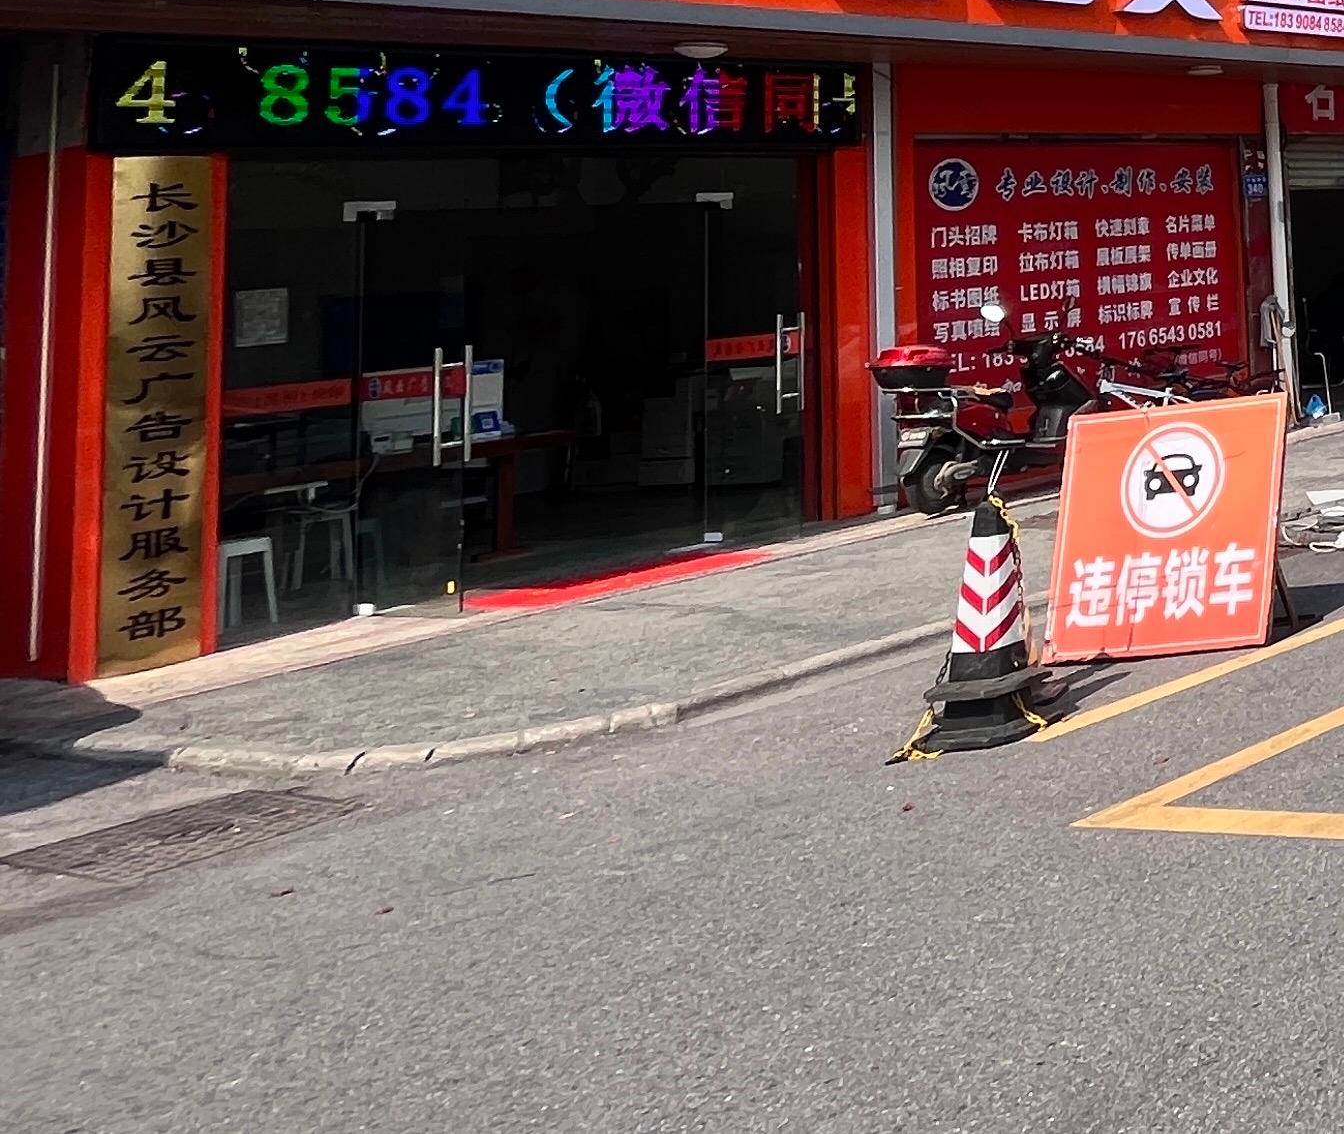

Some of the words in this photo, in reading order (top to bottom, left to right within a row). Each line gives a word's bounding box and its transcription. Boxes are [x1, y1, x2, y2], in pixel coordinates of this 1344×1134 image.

[930, 224, 998, 249] 门头招牌
[1019, 278, 1081, 302] LED灯箱
[1167, 266, 1219, 289] 企业文化
[1118, 329, 1146, 350] 176
[1148, 325, 1186, 346] 6543
[1188, 320, 1222, 341] 0581
[117, 182, 199, 643] 长沙县风云广告设计服务部
[1065, 542, 1257, 630] 违停锁车
